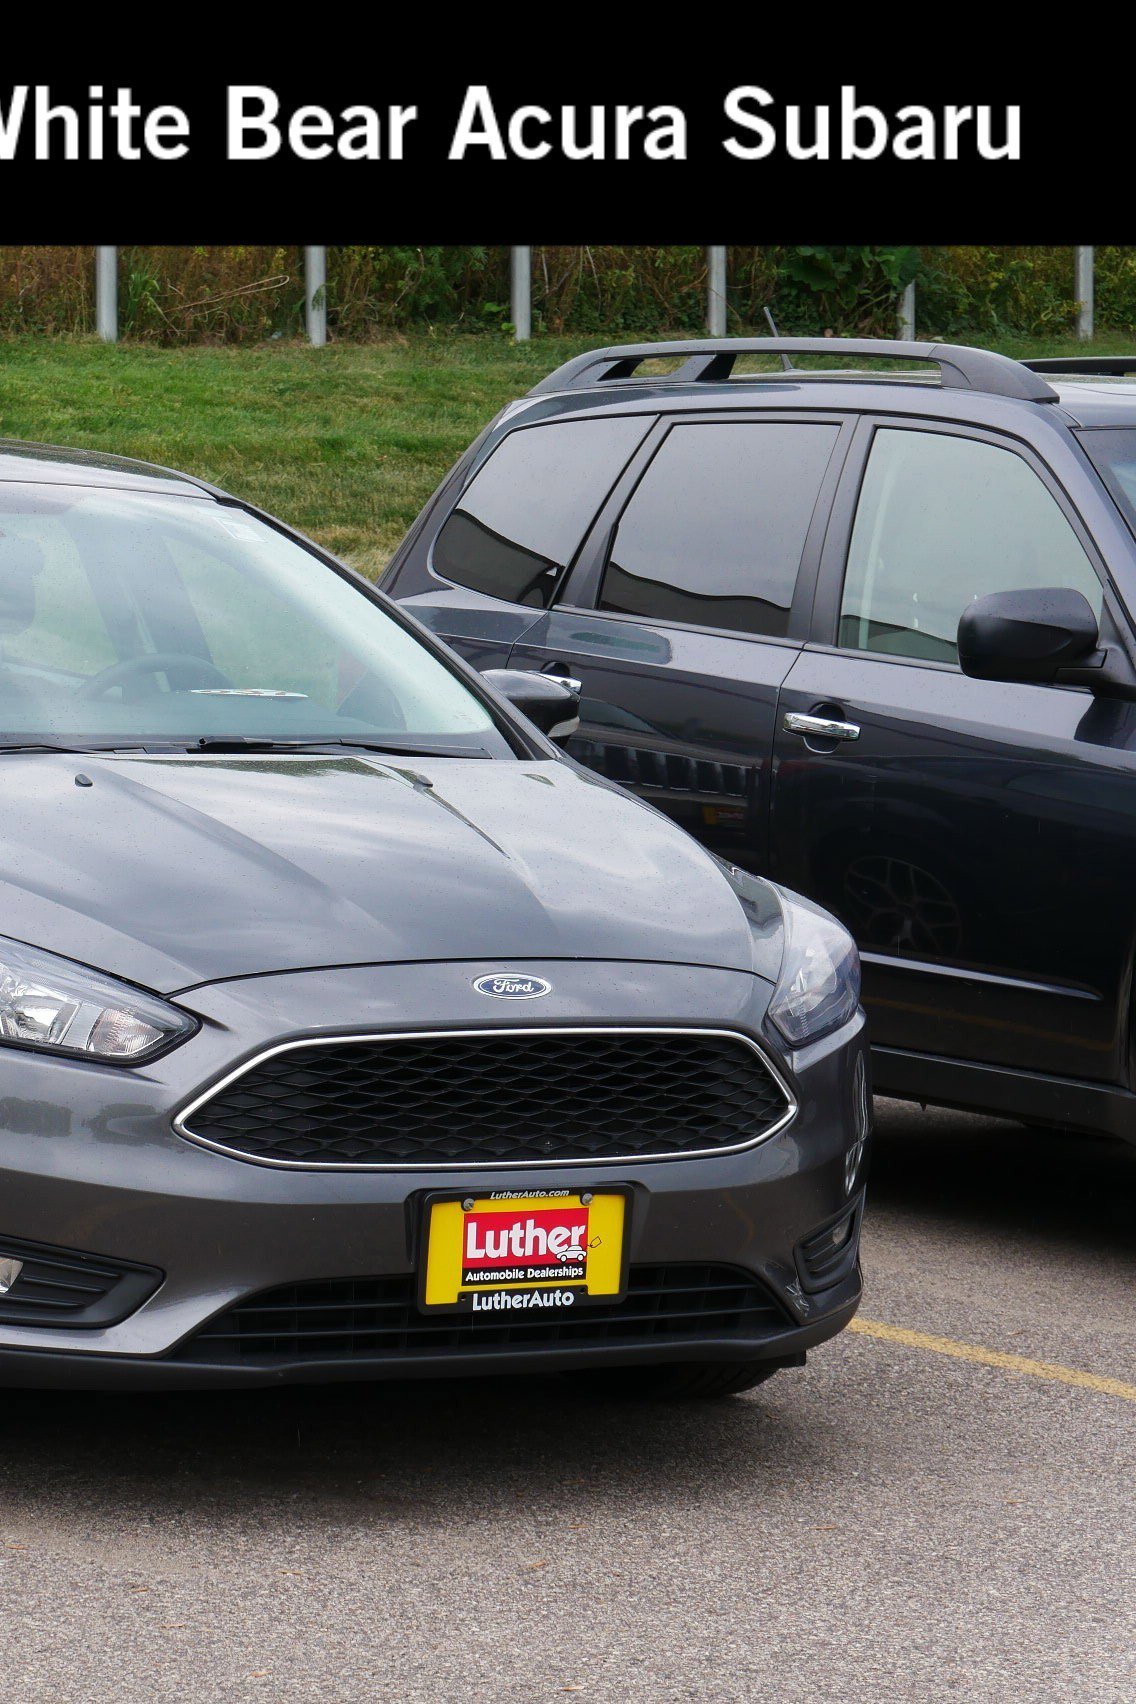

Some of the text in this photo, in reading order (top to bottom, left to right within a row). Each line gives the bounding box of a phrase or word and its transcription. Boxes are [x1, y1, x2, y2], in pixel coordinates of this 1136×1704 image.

[492, 978, 535, 993] Ford
[489, 1189, 570, 1200] LutherAuto.com
[466, 1219, 586, 1259] Luther
[465, 1265, 584, 1282] Automobile Dealerships
[472, 1289, 575, 1311] LutherAuto
